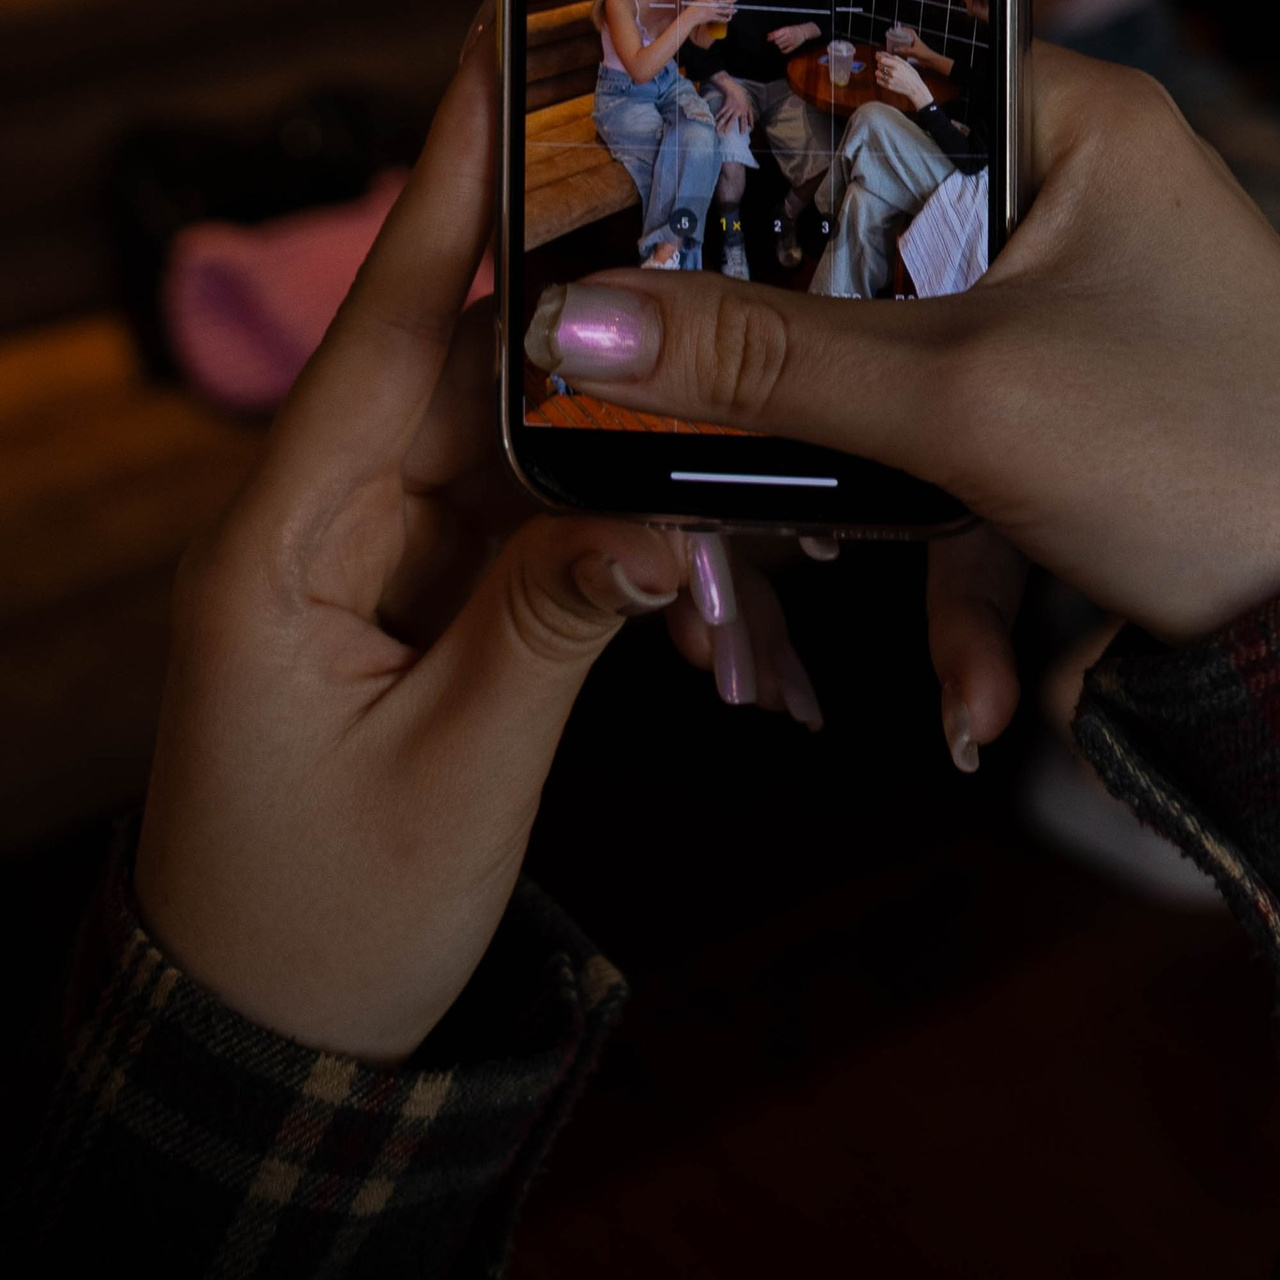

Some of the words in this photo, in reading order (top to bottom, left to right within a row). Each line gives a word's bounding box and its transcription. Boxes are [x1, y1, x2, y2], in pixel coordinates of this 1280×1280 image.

[676, 216, 690, 230] .5
[773, 219, 783, 233] 2
[821, 220, 830, 234] 3
